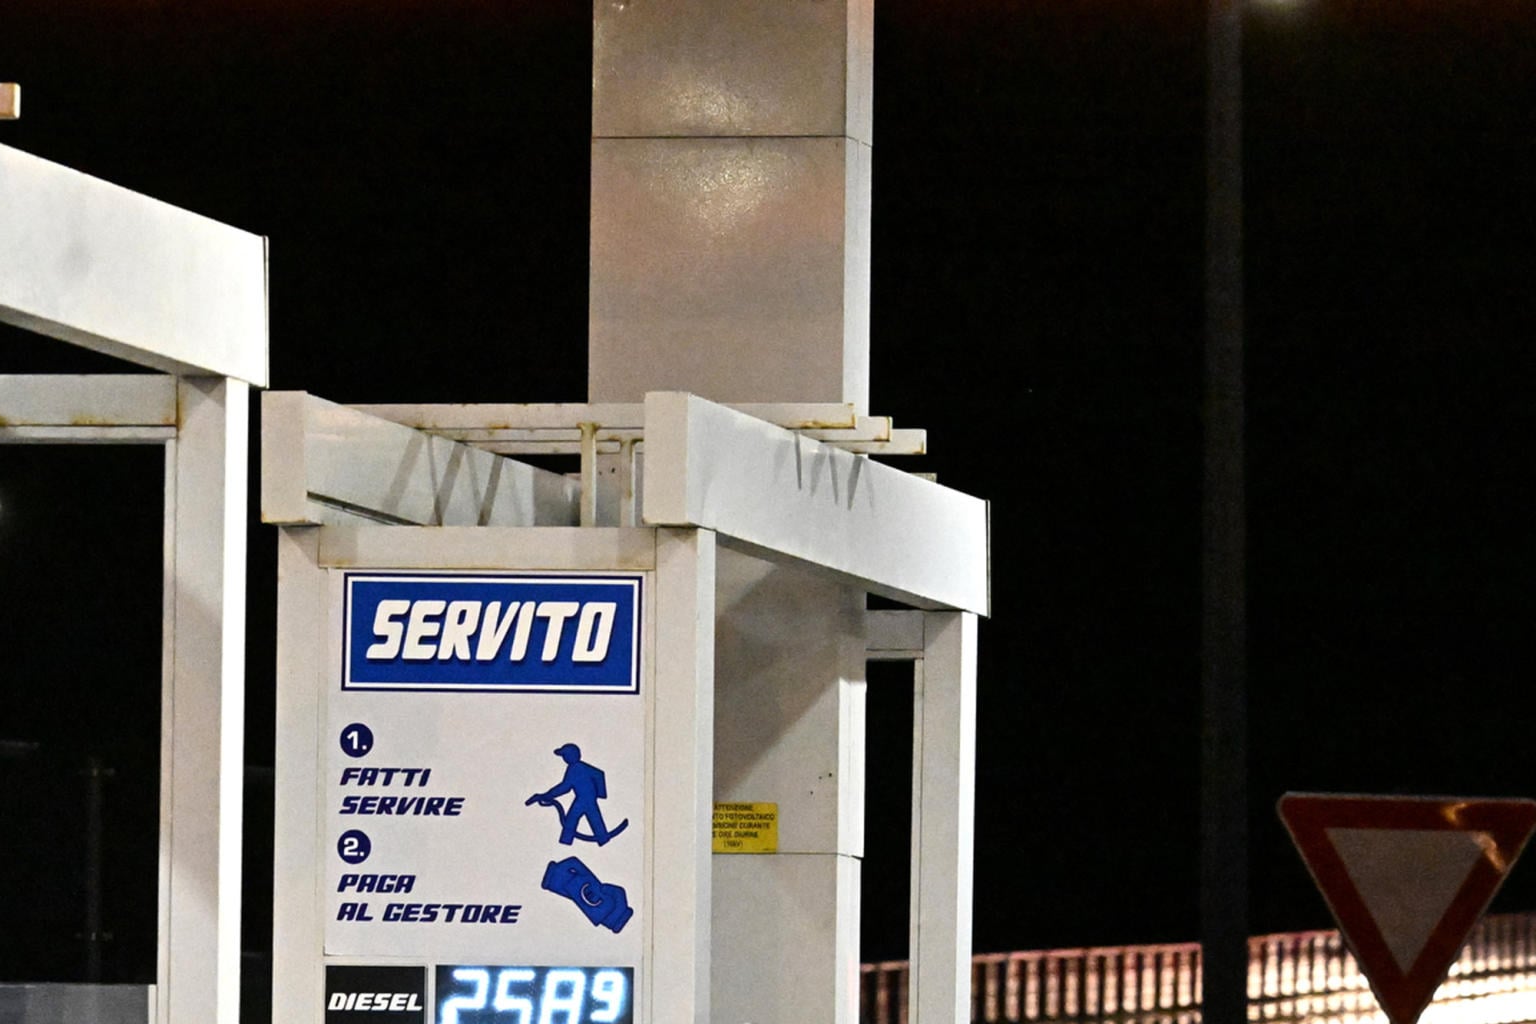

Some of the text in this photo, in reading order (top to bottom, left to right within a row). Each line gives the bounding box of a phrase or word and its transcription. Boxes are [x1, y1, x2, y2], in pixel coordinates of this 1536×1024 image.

[366, 600, 617, 662] SERVITO
[340, 768, 432, 788] FATTI
[339, 796, 466, 817] SERVIRE
[337, 874, 416, 894] PAGA
[336, 903, 522, 924] AL GESTORE
[327, 993, 423, 1012] DIESEL
